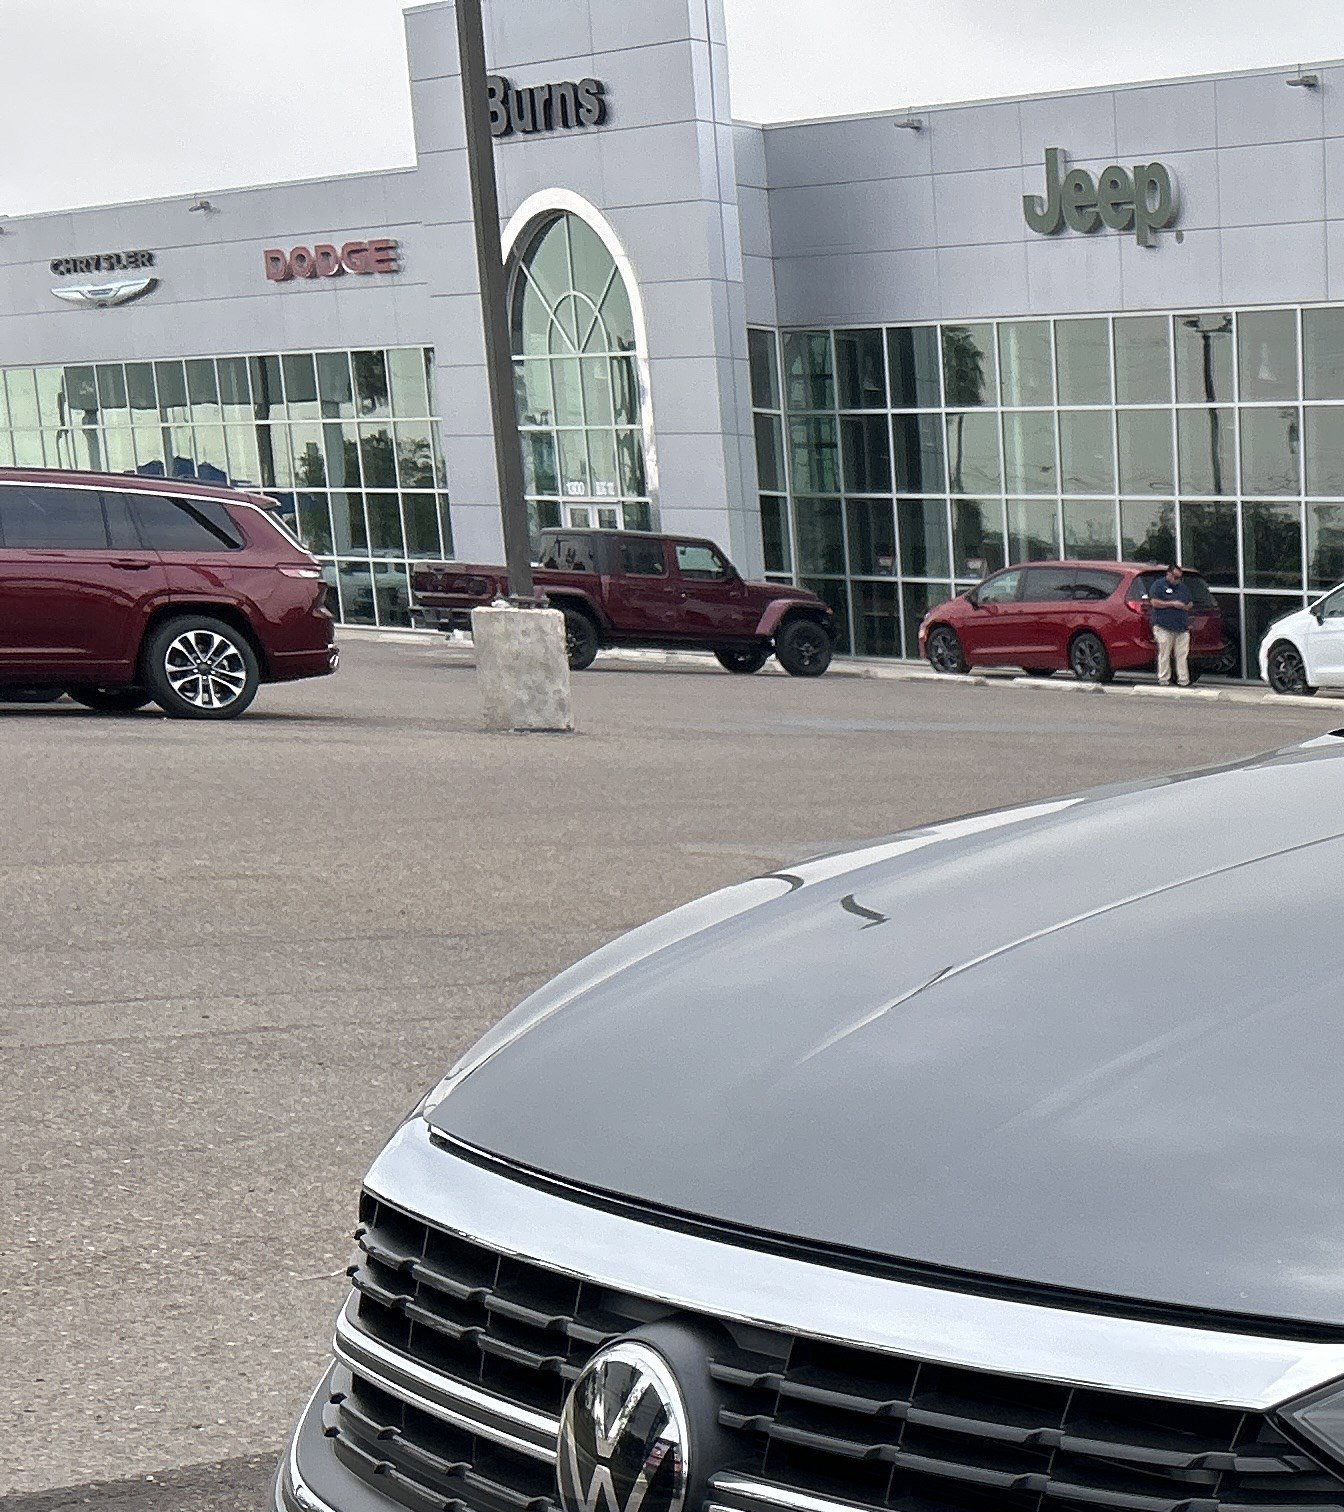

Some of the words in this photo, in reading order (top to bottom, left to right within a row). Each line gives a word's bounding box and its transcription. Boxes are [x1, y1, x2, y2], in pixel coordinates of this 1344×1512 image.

[488, 75, 606, 137] Burns
[1023, 147, 1181, 248] Jeep
[50, 249, 155, 276] CHRYSLER
[264, 238, 400, 282] DODGE
